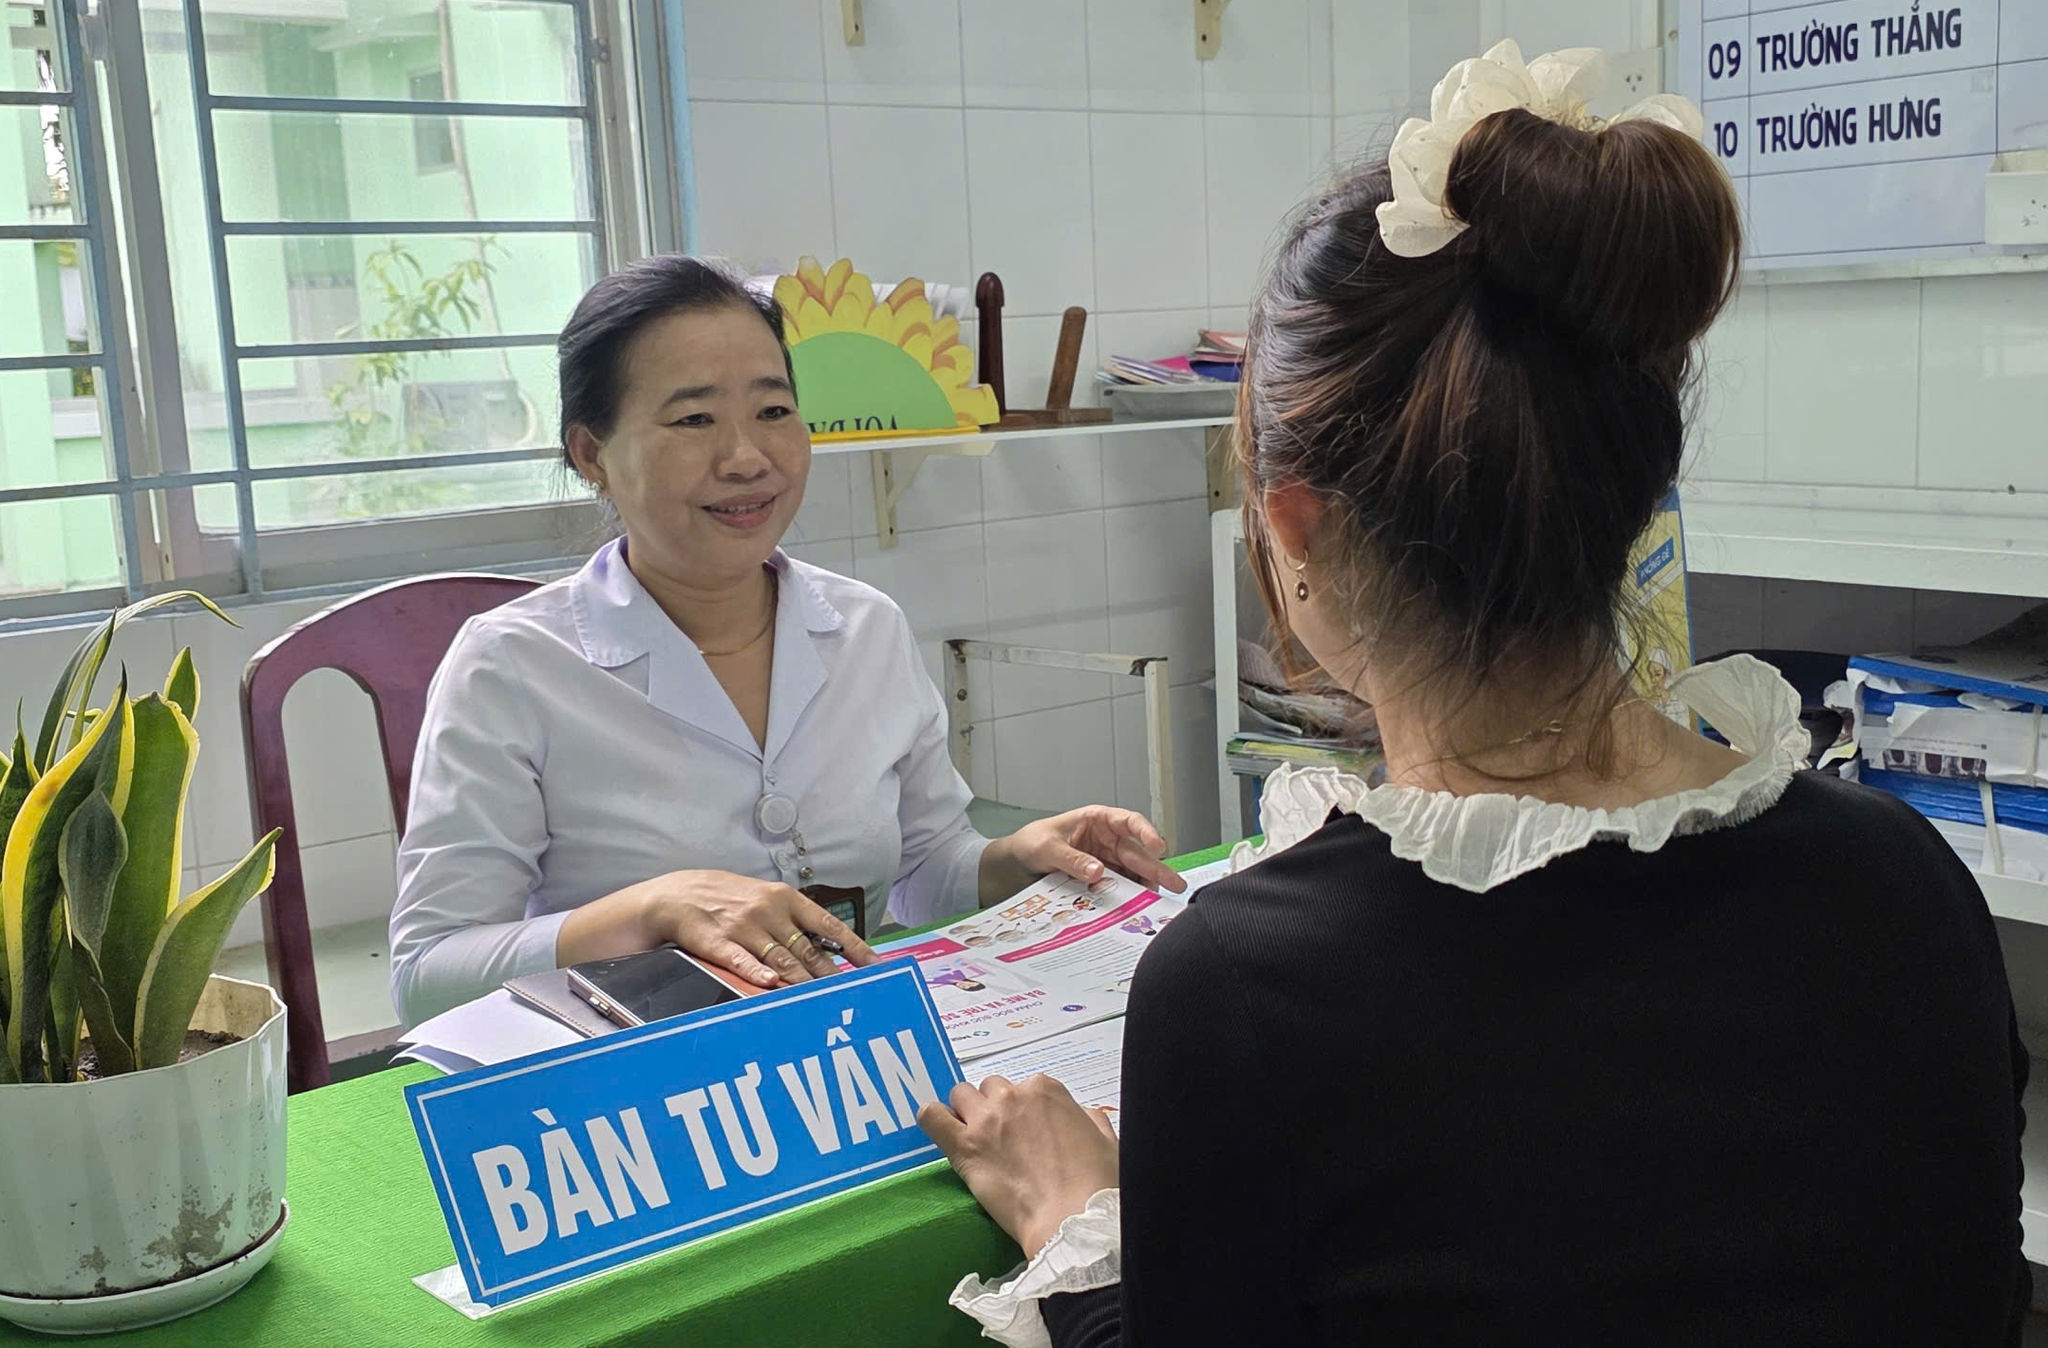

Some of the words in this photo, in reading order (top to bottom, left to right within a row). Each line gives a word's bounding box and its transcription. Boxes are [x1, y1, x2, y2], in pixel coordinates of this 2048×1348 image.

[1708, 41, 1741, 80] 09
[1757, 19, 1859, 73] TRƯỜNG
[1871, 0, 1962, 58] THẮNG
[1713, 121, 1738, 158] 10
[1757, 103, 1857, 154] TRƯỜNG
[1868, 97, 1941, 143] HƯNG
[472, 1107, 671, 1257] BÀN
[664, 1061, 780, 1192] TƯ
[776, 1008, 939, 1155] VẤN
